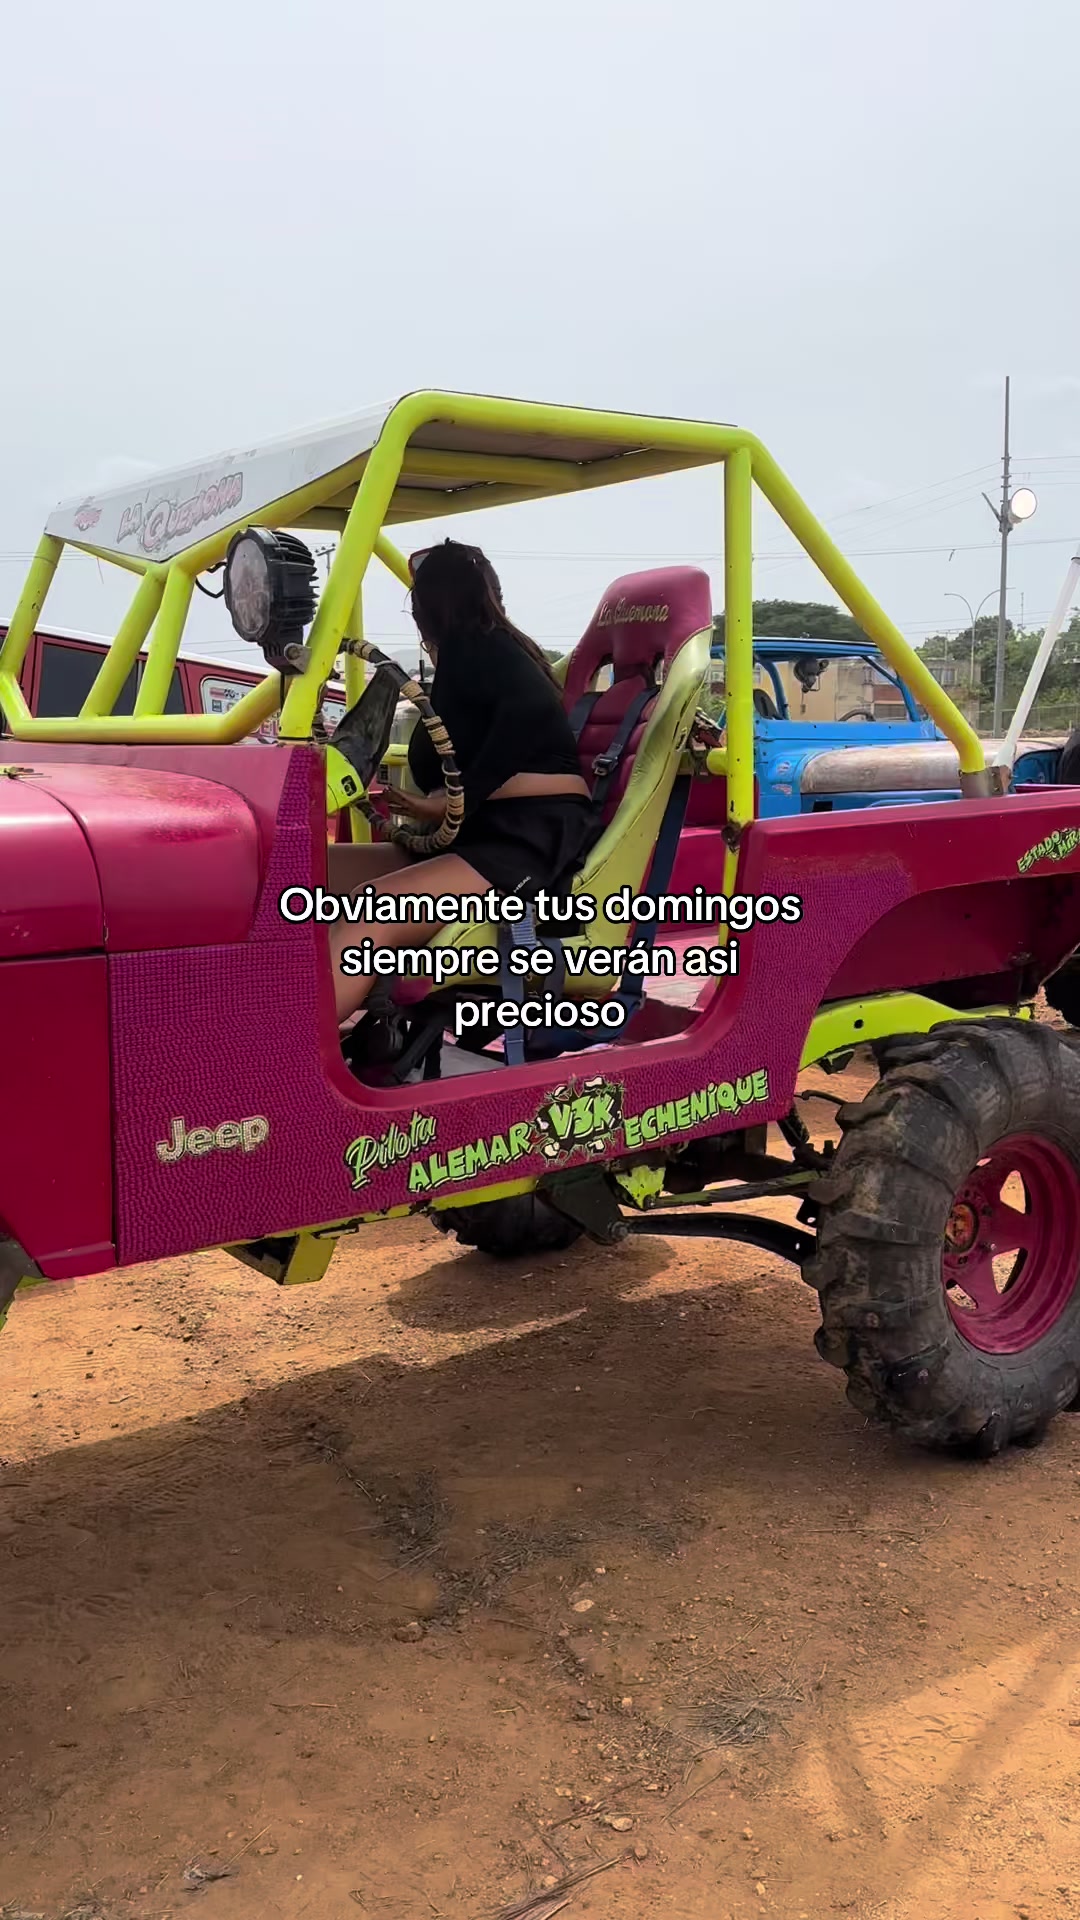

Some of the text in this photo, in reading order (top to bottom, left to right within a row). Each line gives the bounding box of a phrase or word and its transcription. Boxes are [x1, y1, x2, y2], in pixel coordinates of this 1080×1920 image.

[1016, 829, 1061, 873] ESTADO
[1057, 827, 1080, 857] MIR
[156, 1115, 269, 1162] Jeep
[345, 1110, 437, 1190] Pilota
[408, 1121, 533, 1193] ALEMAR
